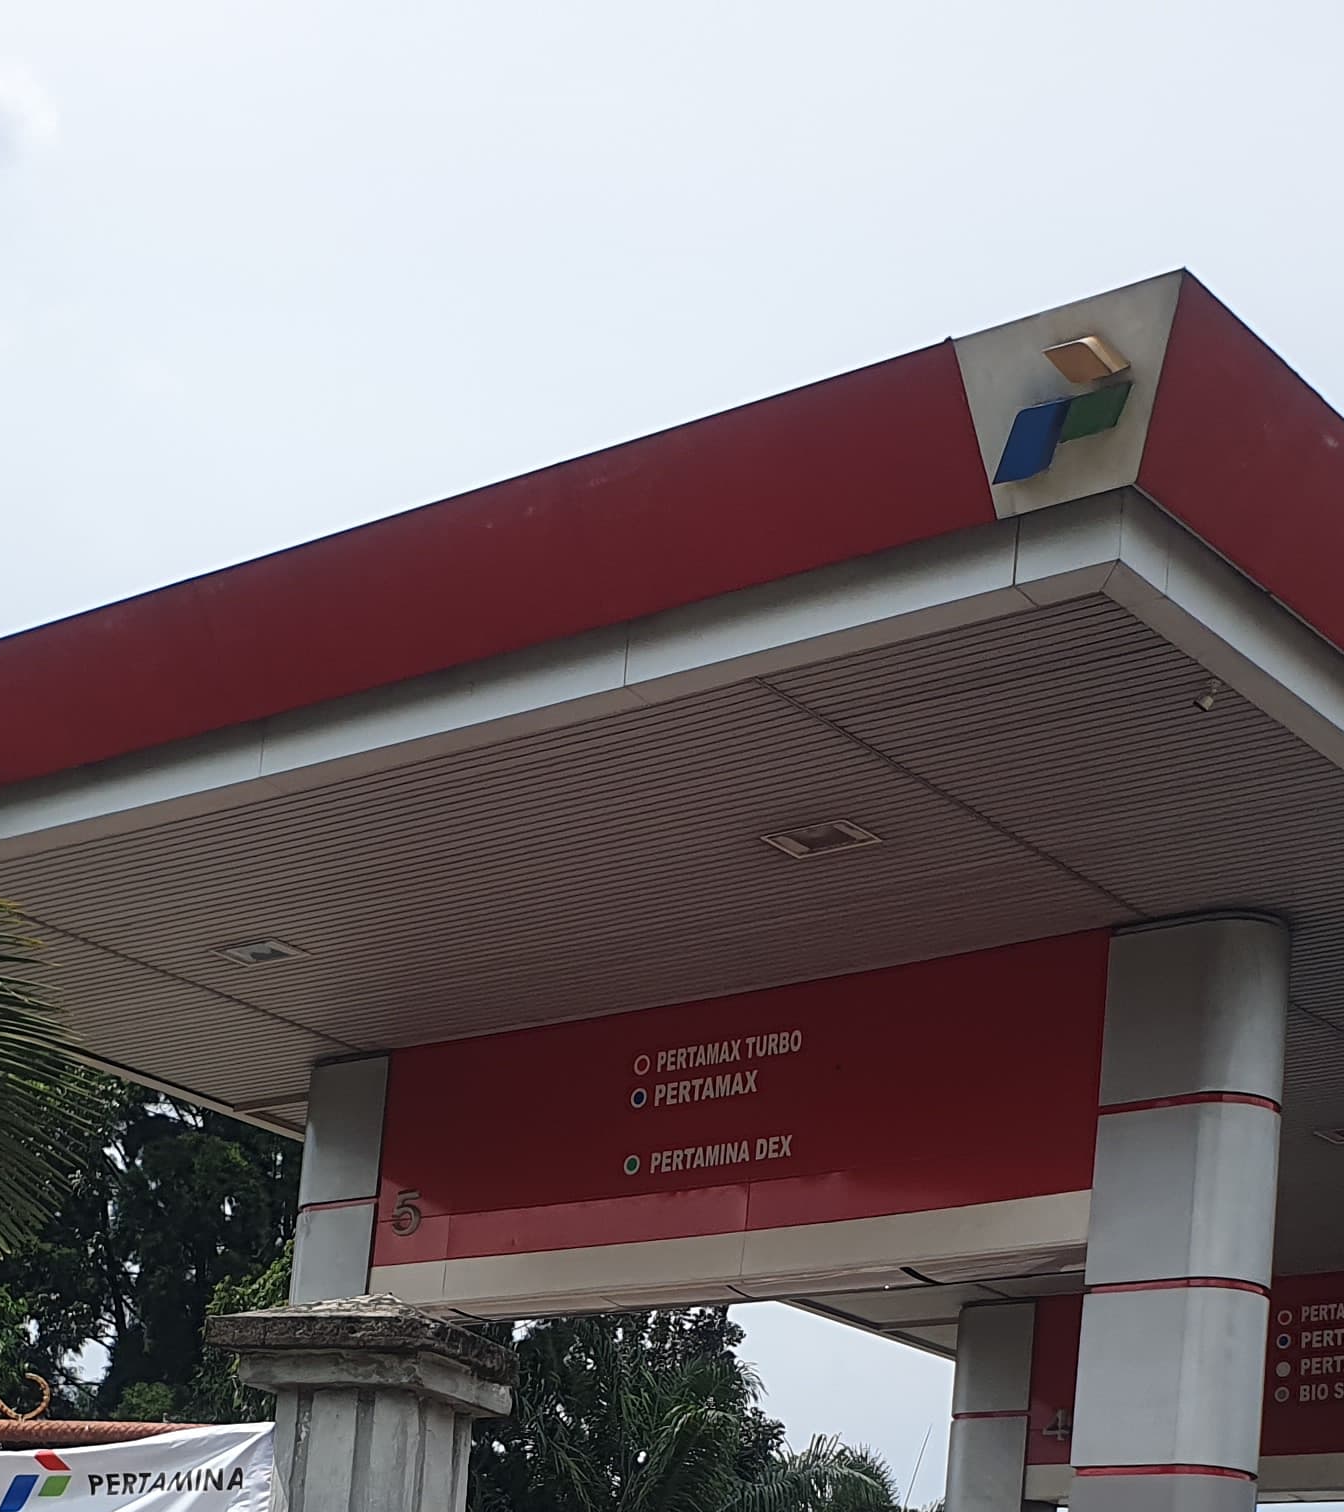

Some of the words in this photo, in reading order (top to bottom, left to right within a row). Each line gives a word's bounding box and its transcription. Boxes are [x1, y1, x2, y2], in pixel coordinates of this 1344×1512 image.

[656, 1040, 741, 1071] PERTAMAX
[746, 1029, 803, 1060] TURBO
[654, 1070, 758, 1107] PERTAMAX
[650, 1140, 750, 1175] PERTAMINA
[755, 1135, 793, 1162] DEX
[392, 1190, 422, 1237] 5
[1299, 1383, 1329, 1402] BIO
[88, 1466, 245, 1494] PERTAMINA
